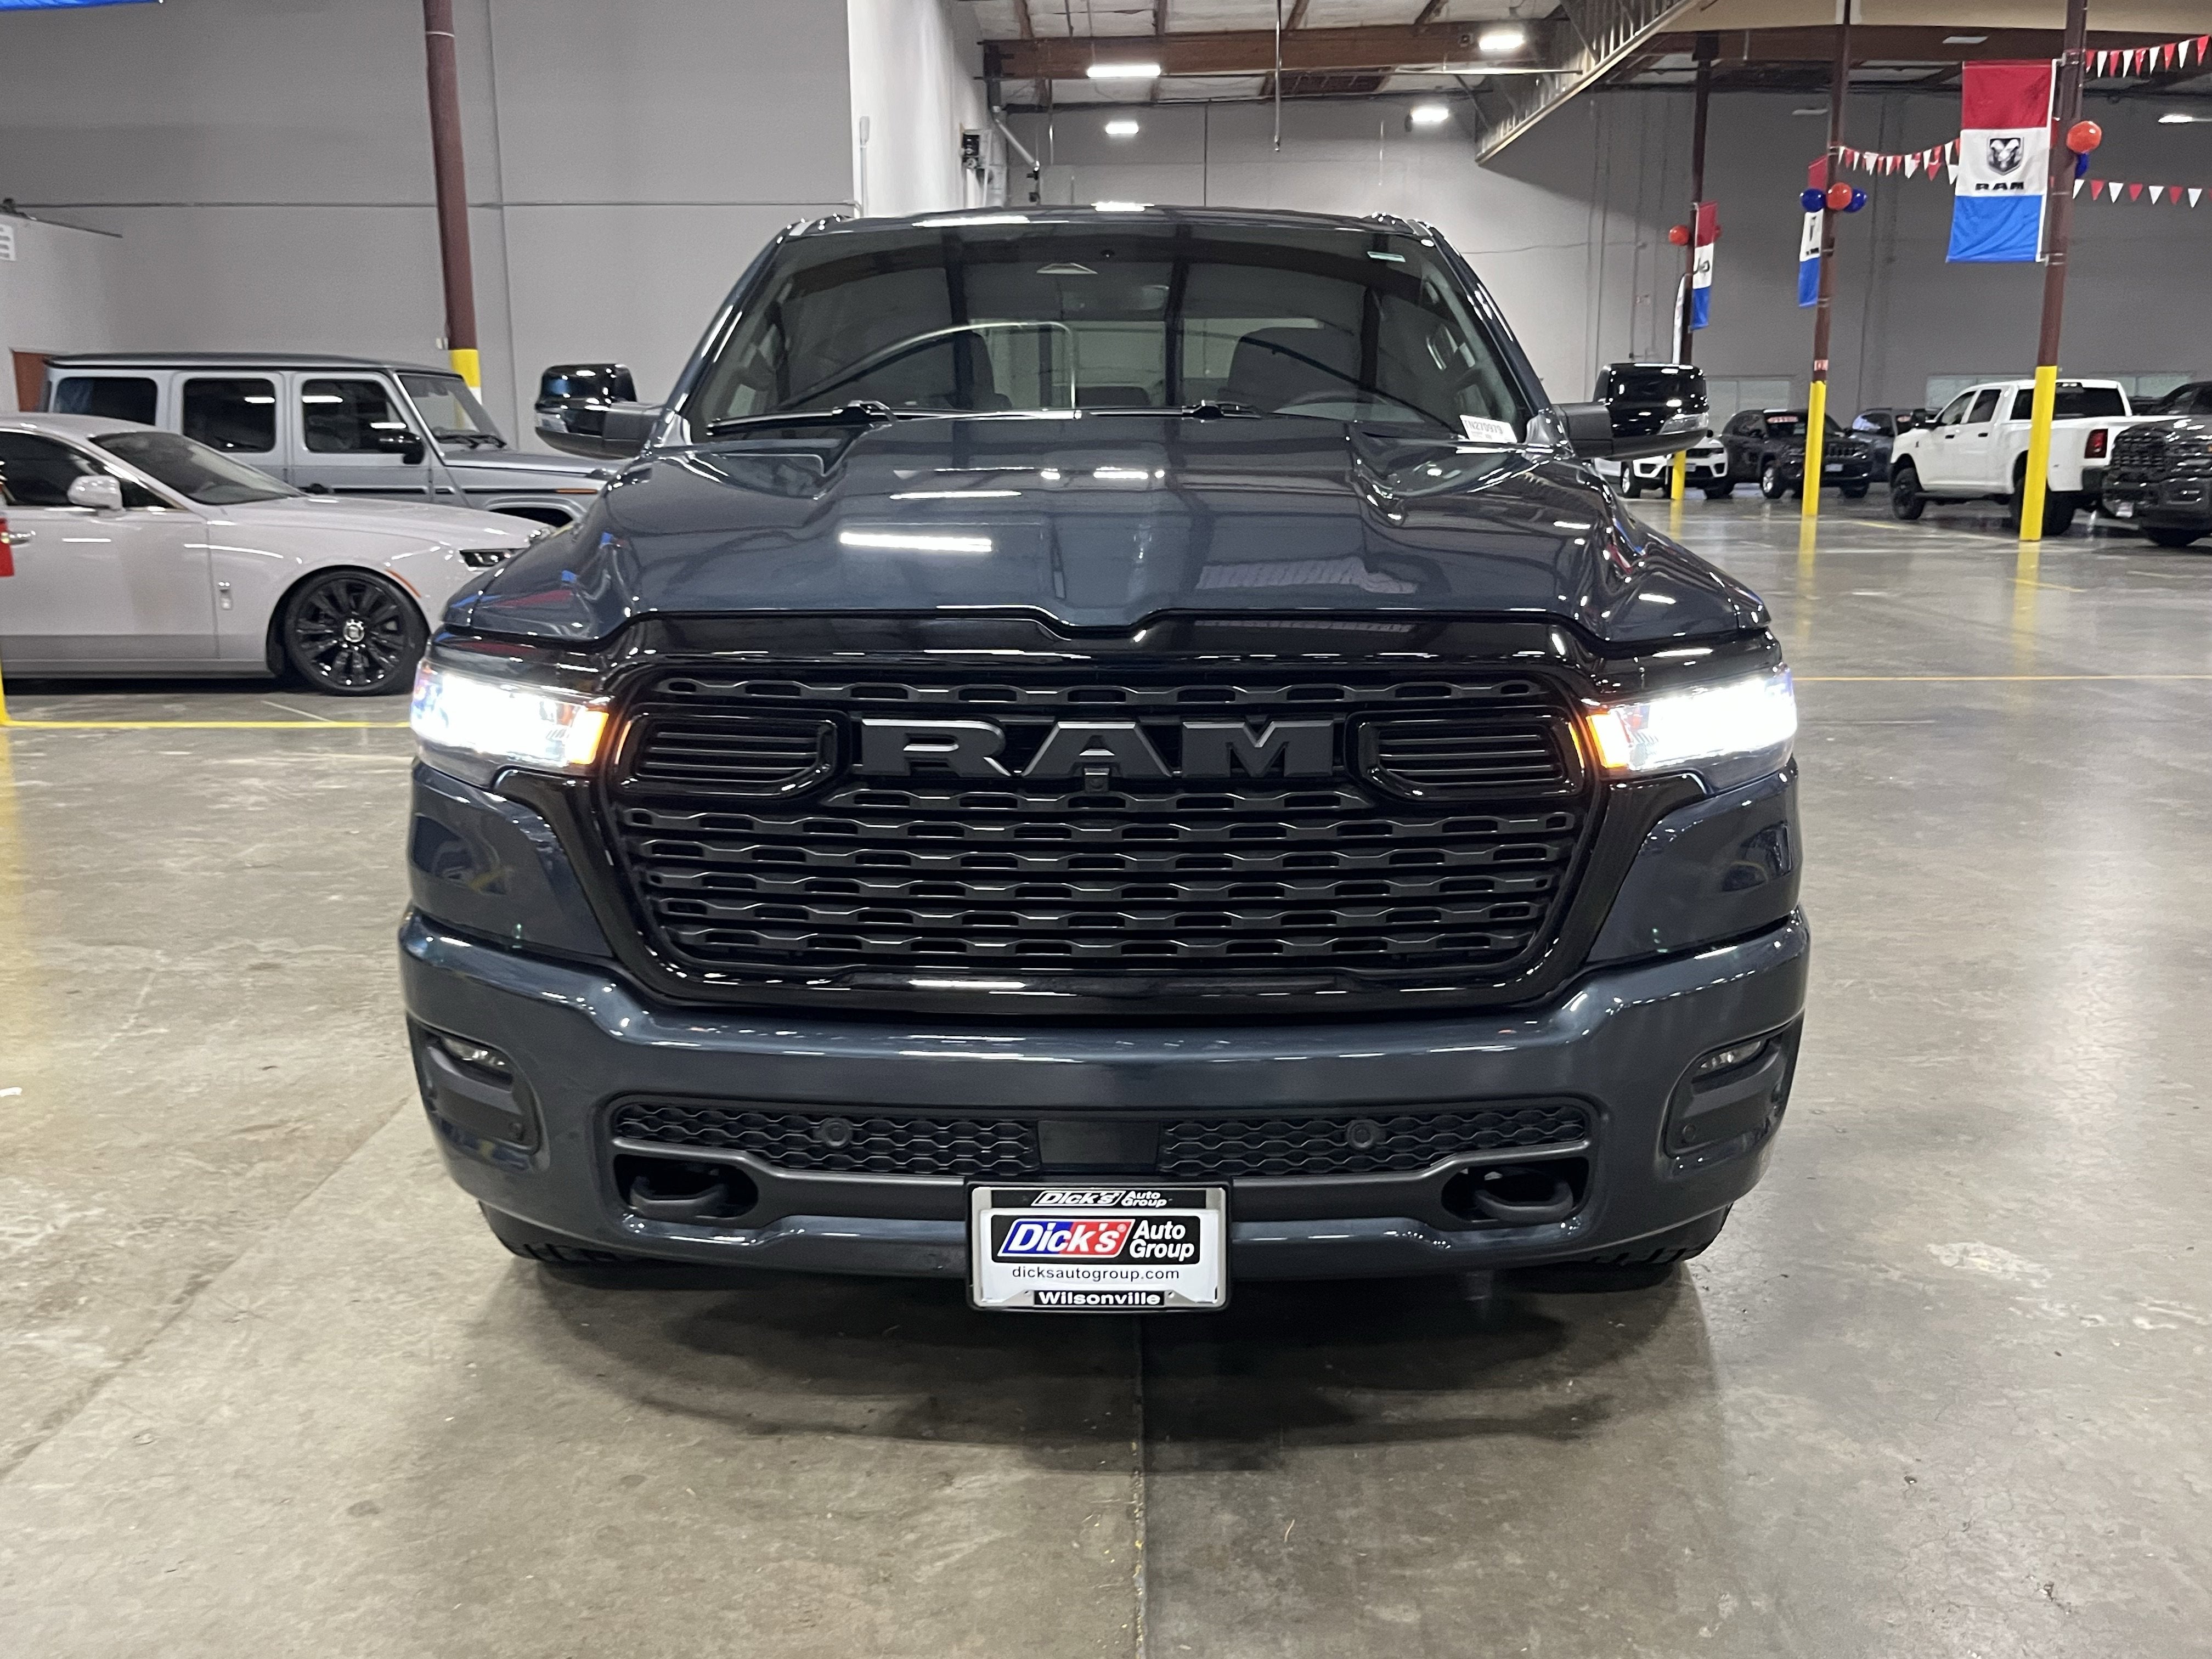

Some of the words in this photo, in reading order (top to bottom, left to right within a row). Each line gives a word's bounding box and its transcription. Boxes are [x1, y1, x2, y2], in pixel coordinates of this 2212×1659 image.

[1976, 182, 2024, 190] RAM
[862, 719, 1334, 777] RAM
[1121, 1198, 1167, 1207] Group
[1125, 1190, 1161, 1199] Auto
[1008, 1223, 1120, 1252] Dick's
[1133, 1220, 1186, 1240] Auto
[1129, 1239, 1195, 1261] Group
[1012, 1266, 1179, 1282] dicksautogroup.com
[1039, 1291, 1161, 1305] Wilsonville
